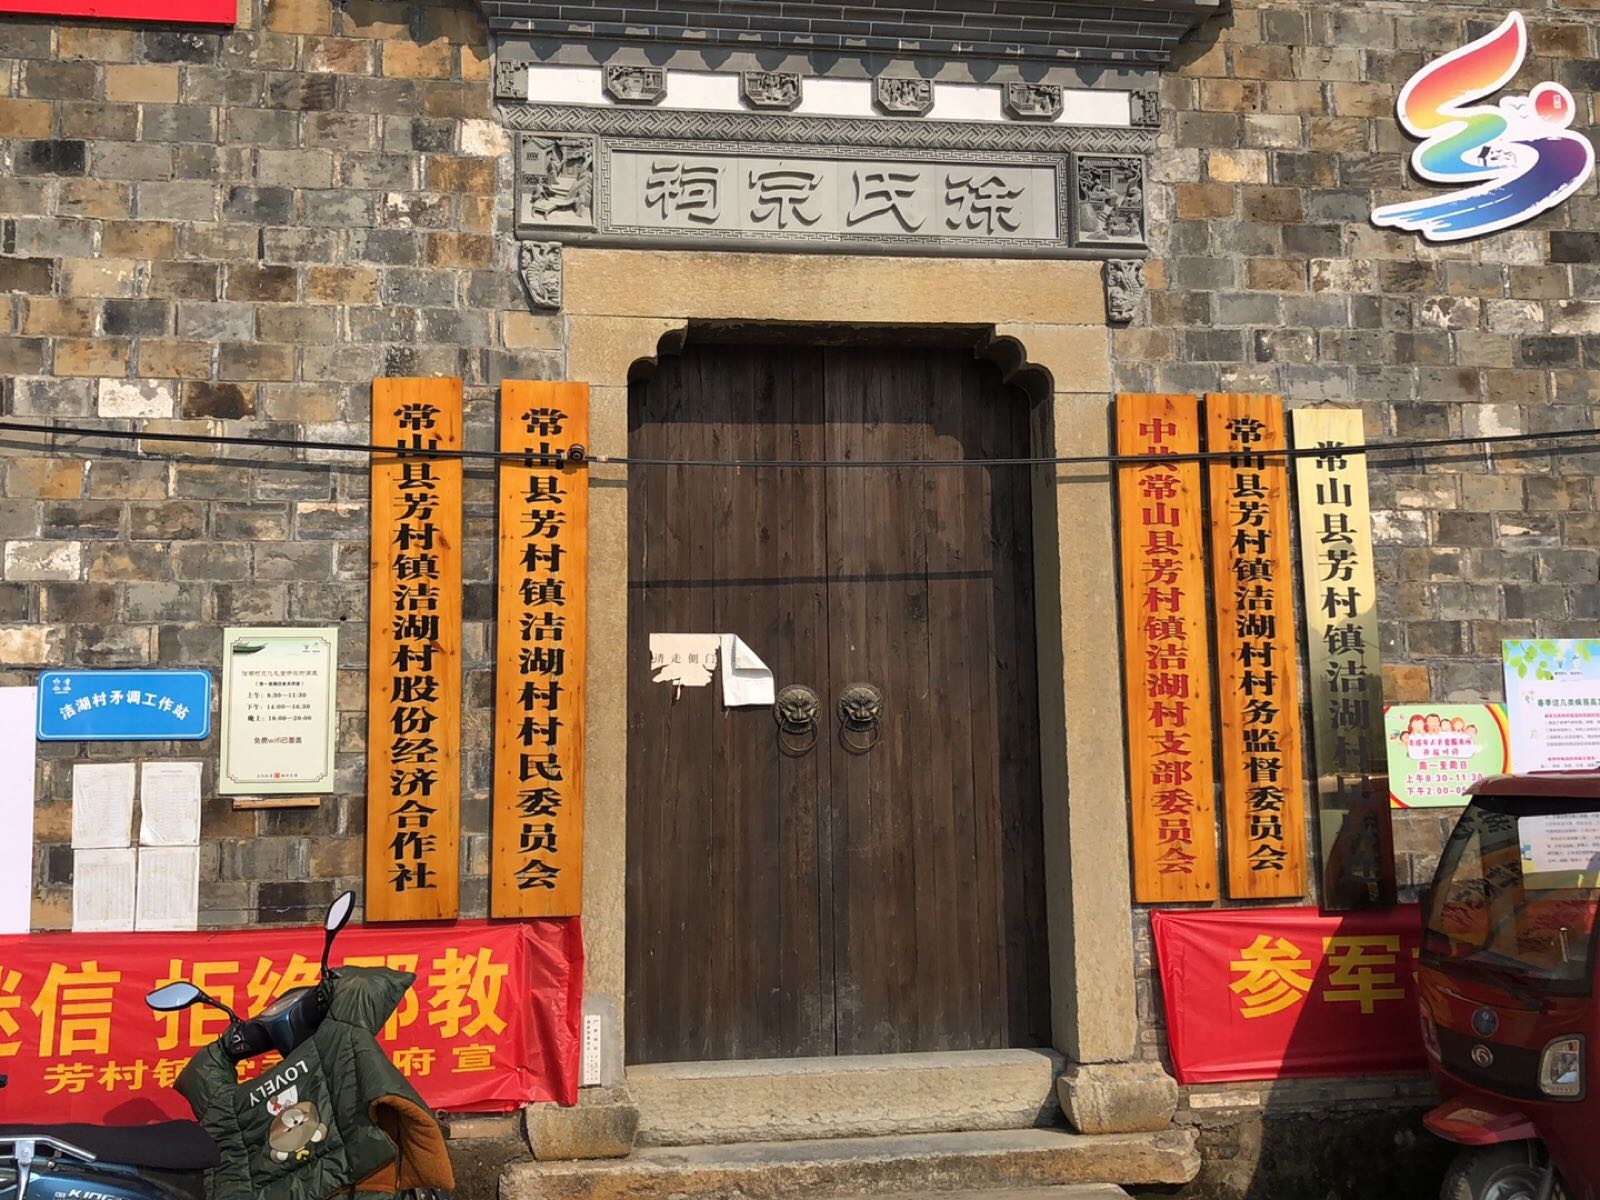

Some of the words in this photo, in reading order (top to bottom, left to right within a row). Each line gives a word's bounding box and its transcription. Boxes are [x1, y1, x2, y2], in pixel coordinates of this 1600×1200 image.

[388, 403, 441, 892] 常山县芳村镇洁湖村股份经济合作社
[514, 407, 568, 890] 常山县芳村镇洁湖村村民委员会
[651, 652, 717, 664] 请走侧门
[1138, 418, 1197, 875] 中共常山县芳村镇洁湖村支部委员会
[1224, 418, 1288, 872] 常山县芳村镇洁湖村村务监督委员会
[59, 690, 190, 720] 洁湖村矛调工作站
[1419, 760, 1468, 770] 周一至周日
[1228, 934, 1421, 1019] 参军
[250, 1060, 309, 1107] LOVELY
[451, 1043, 496, 1073] 宣
